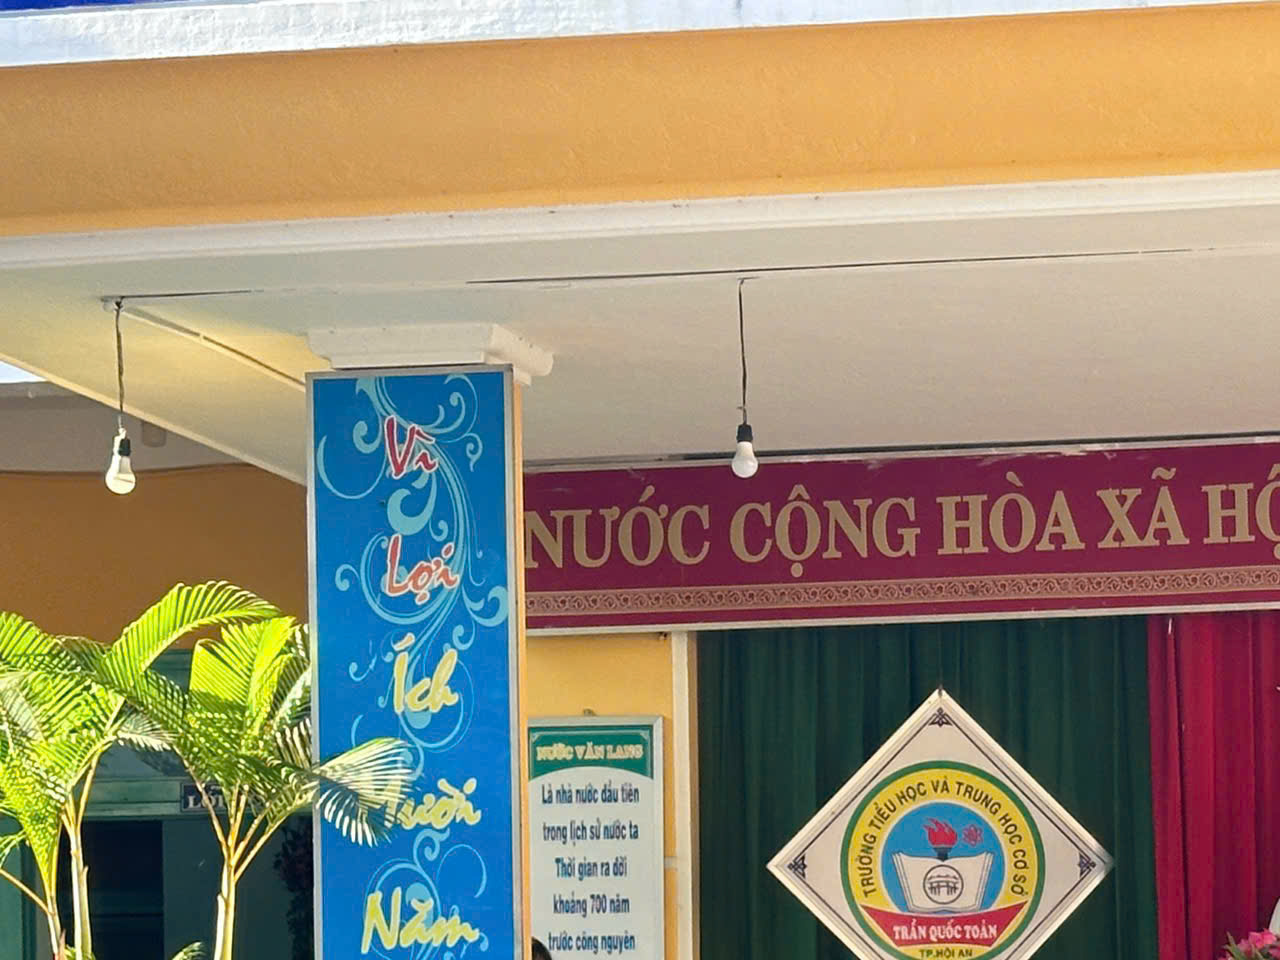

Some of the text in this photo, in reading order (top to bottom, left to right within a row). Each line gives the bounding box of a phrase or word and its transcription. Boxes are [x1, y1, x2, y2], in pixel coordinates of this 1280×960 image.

[385, 416, 438, 479] Vì
[523, 485, 710, 569] NƯỚC
[729, 484, 920, 577] CỘNG
[936, 471, 1084, 555] HÒA
[1097, 467, 1189, 549] XÃ
[385, 534, 459, 604] Lợi
[393, 632, 459, 713] Ích
[383, 777, 482, 830] ười
[542, 784, 553, 804] Là
[555, 783, 573, 804] nhà
[543, 821, 568, 845] trong
[570, 819, 587, 847] lịch
[603, 819, 627, 840] nước
[629, 819, 639, 839] ta
[857, 776, 1029, 897] TRƯỜNG TIỂU HỌC VÀ TRUNG HỌC CƠ SỞ
[555, 856, 576, 878] Thời
[578, 856, 598, 881] gian
[600, 861, 610, 876] ra
[361, 886, 480, 954] Năm
[553, 890, 630, 918] khoảng 700 năm
[929, 918, 962, 942] QUỐC
[958, 948, 973, 958] AN
